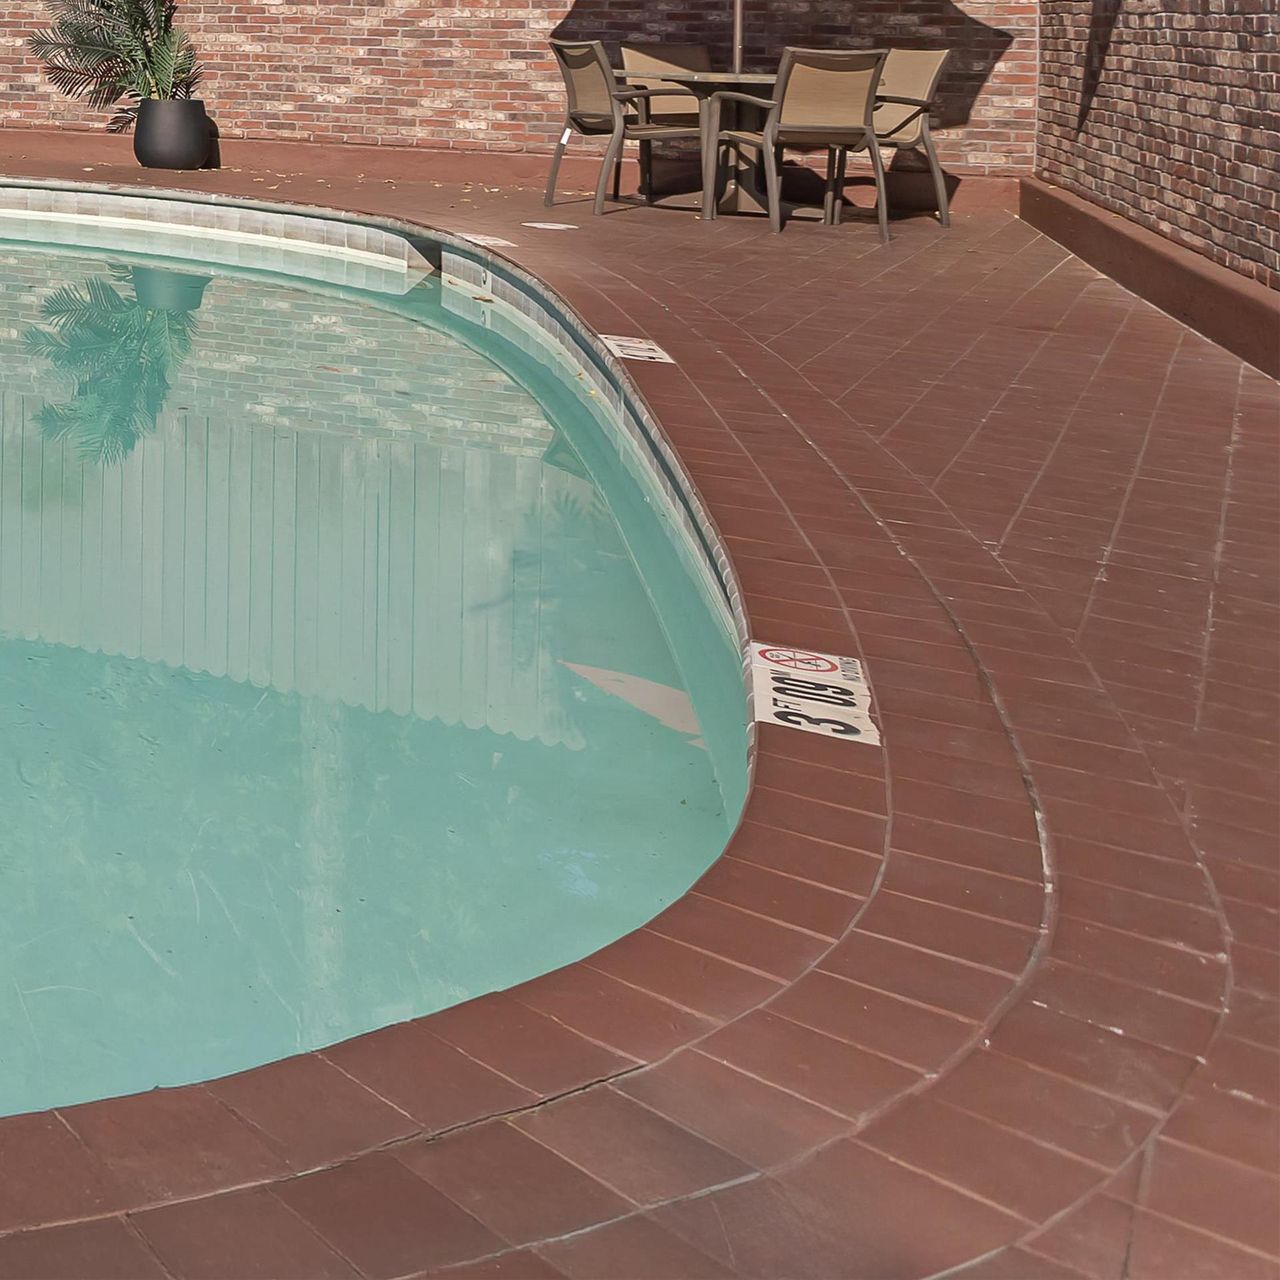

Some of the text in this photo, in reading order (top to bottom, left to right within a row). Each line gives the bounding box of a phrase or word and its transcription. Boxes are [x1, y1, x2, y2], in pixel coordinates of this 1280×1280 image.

[771, 676, 857, 707] 0.9
[772, 697, 861, 736] 3 FT
